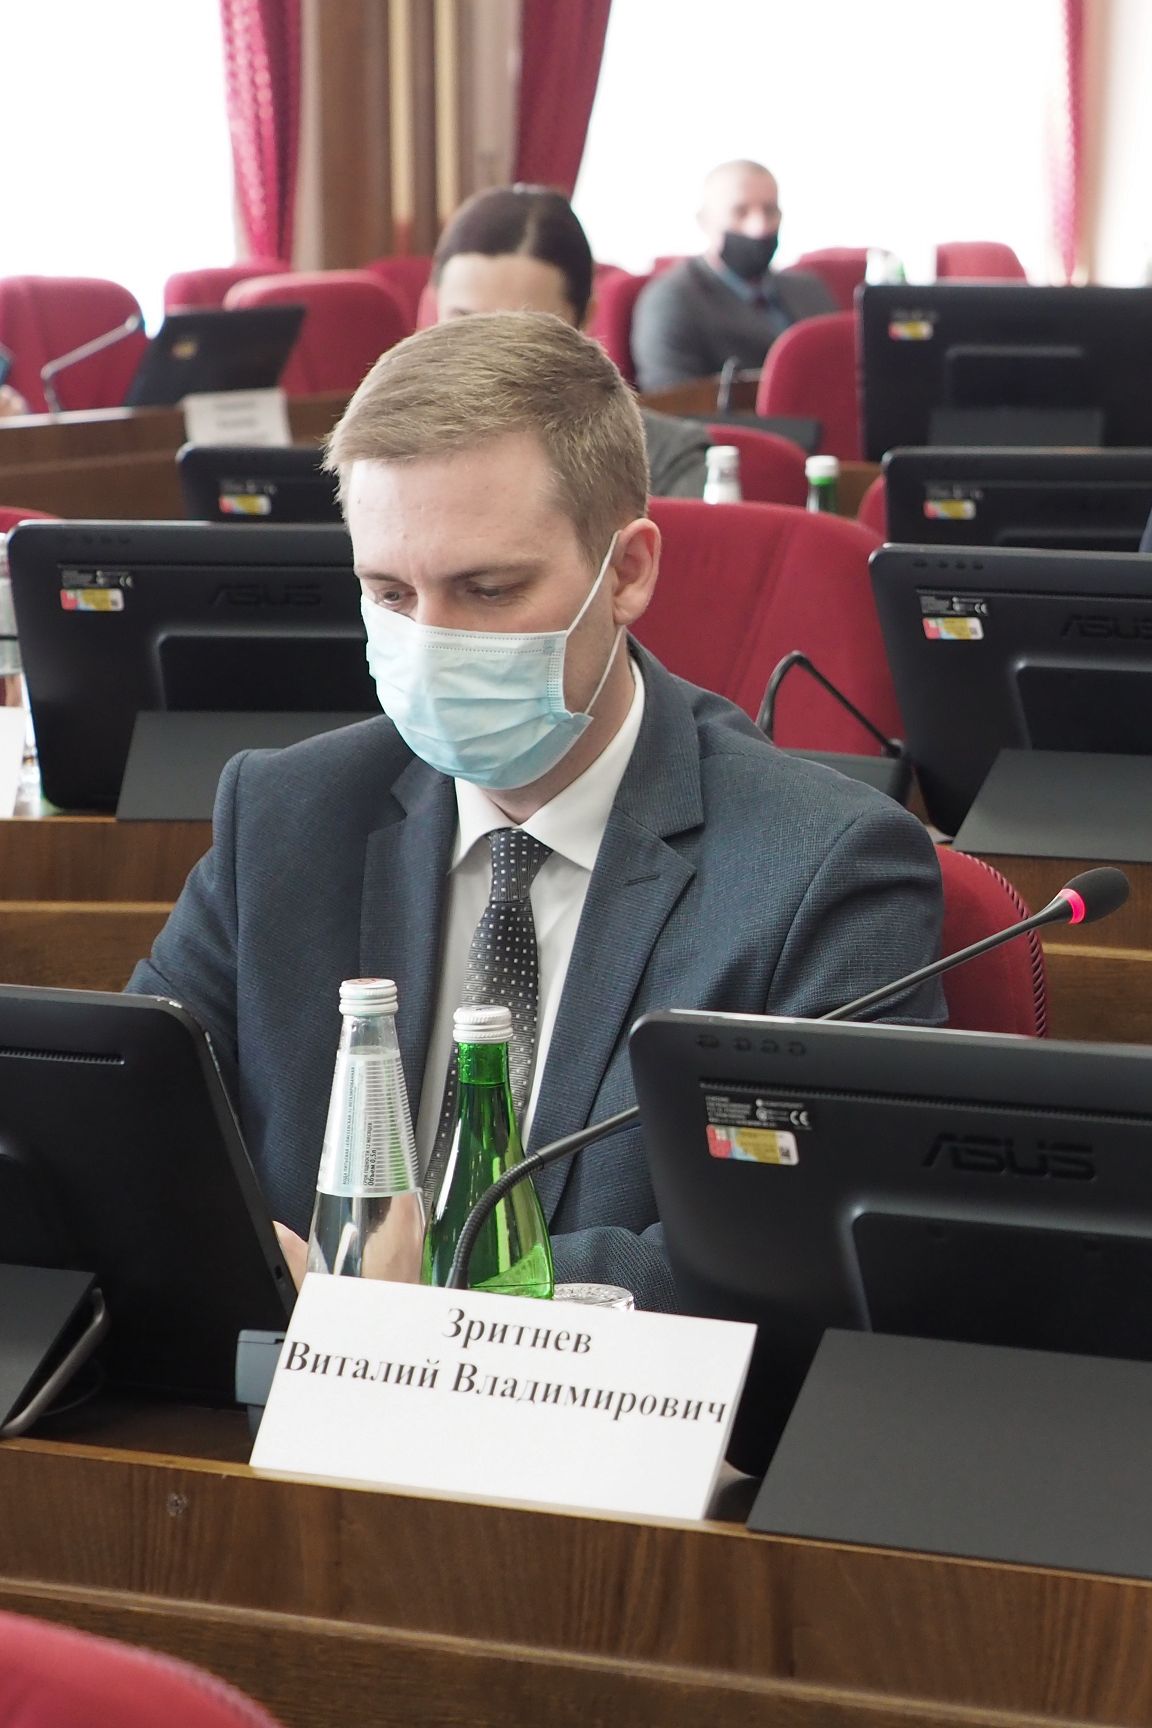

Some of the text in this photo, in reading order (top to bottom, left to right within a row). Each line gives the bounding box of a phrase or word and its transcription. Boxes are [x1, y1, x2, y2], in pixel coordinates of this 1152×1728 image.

[368, 1164, 376, 1186] Объем
[922, 1132, 1097, 1182] ASUS
[442, 1307, 592, 1354] Зритнев
[284, 1341, 727, 1424] Виталий Владимирович
